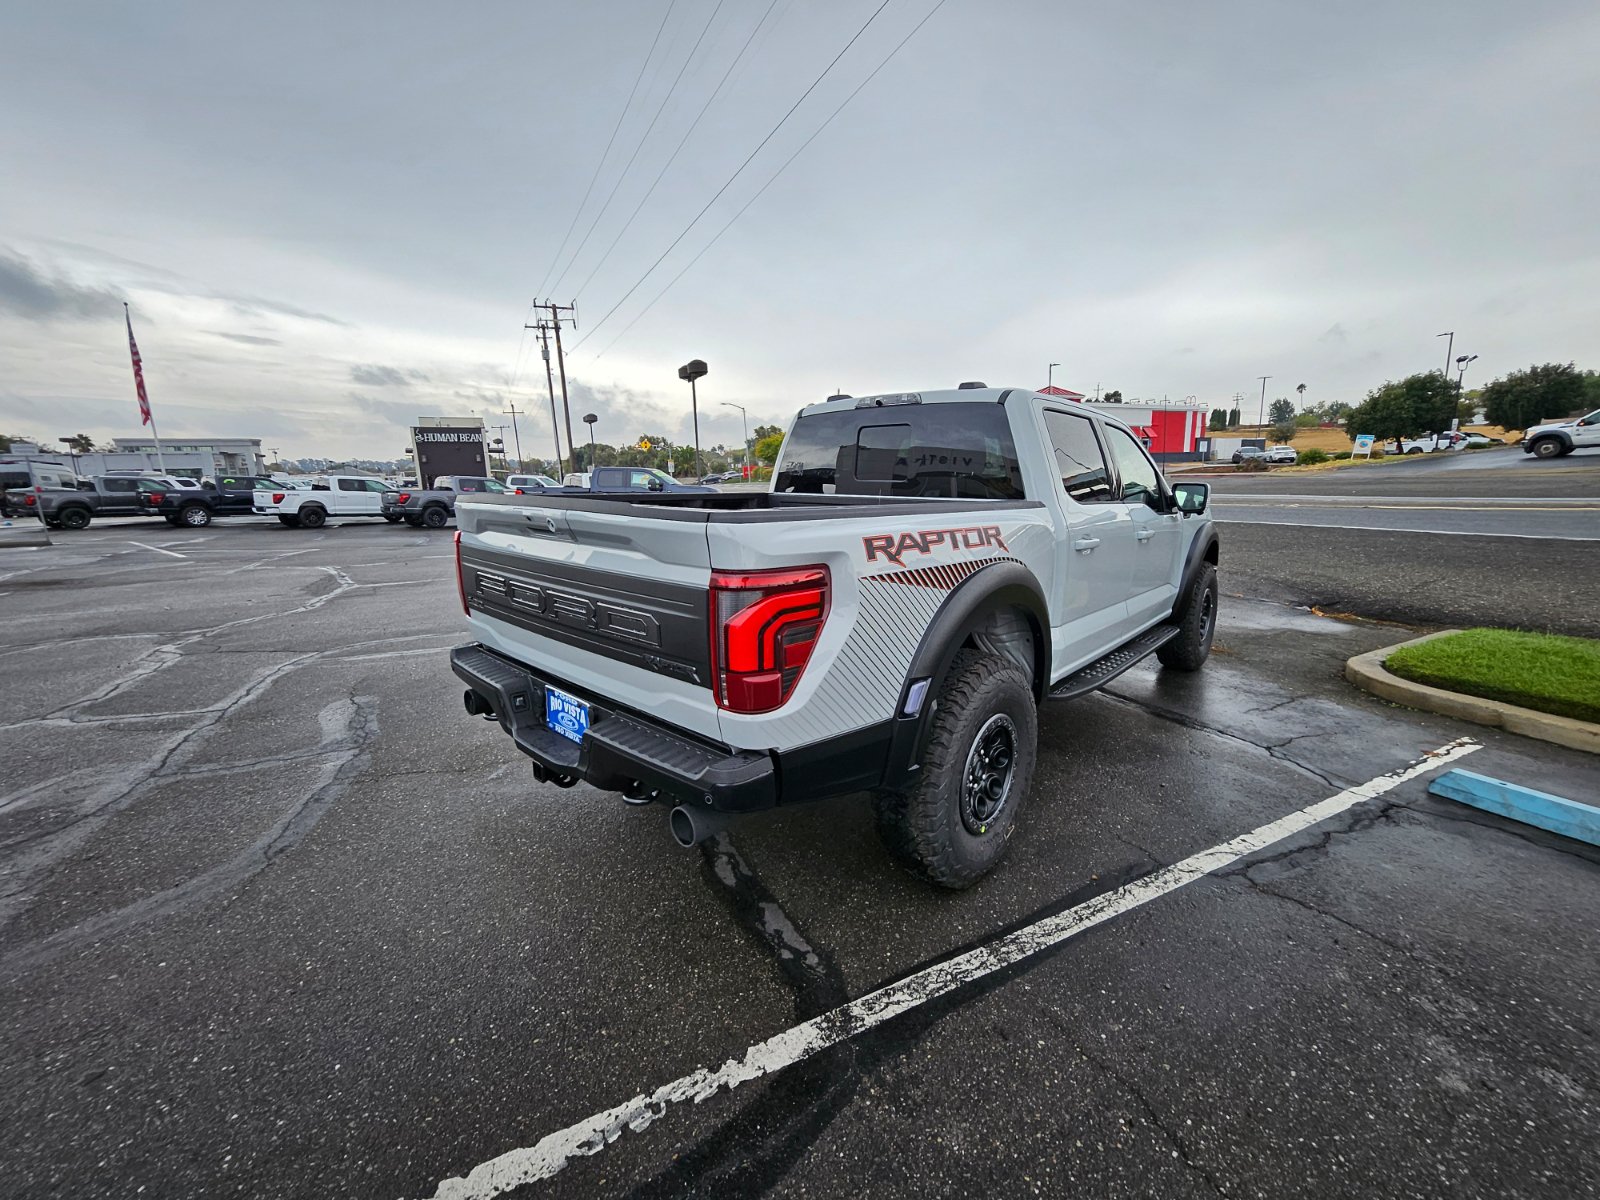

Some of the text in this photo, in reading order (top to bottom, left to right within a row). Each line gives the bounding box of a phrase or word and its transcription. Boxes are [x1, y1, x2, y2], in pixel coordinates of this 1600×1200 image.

[424, 432, 482, 442] HUMAN BEAN
[862, 525, 1009, 568] RAPTOR
[475, 571, 662, 648] FORD
[550, 695, 587, 729] RIO VISTA
